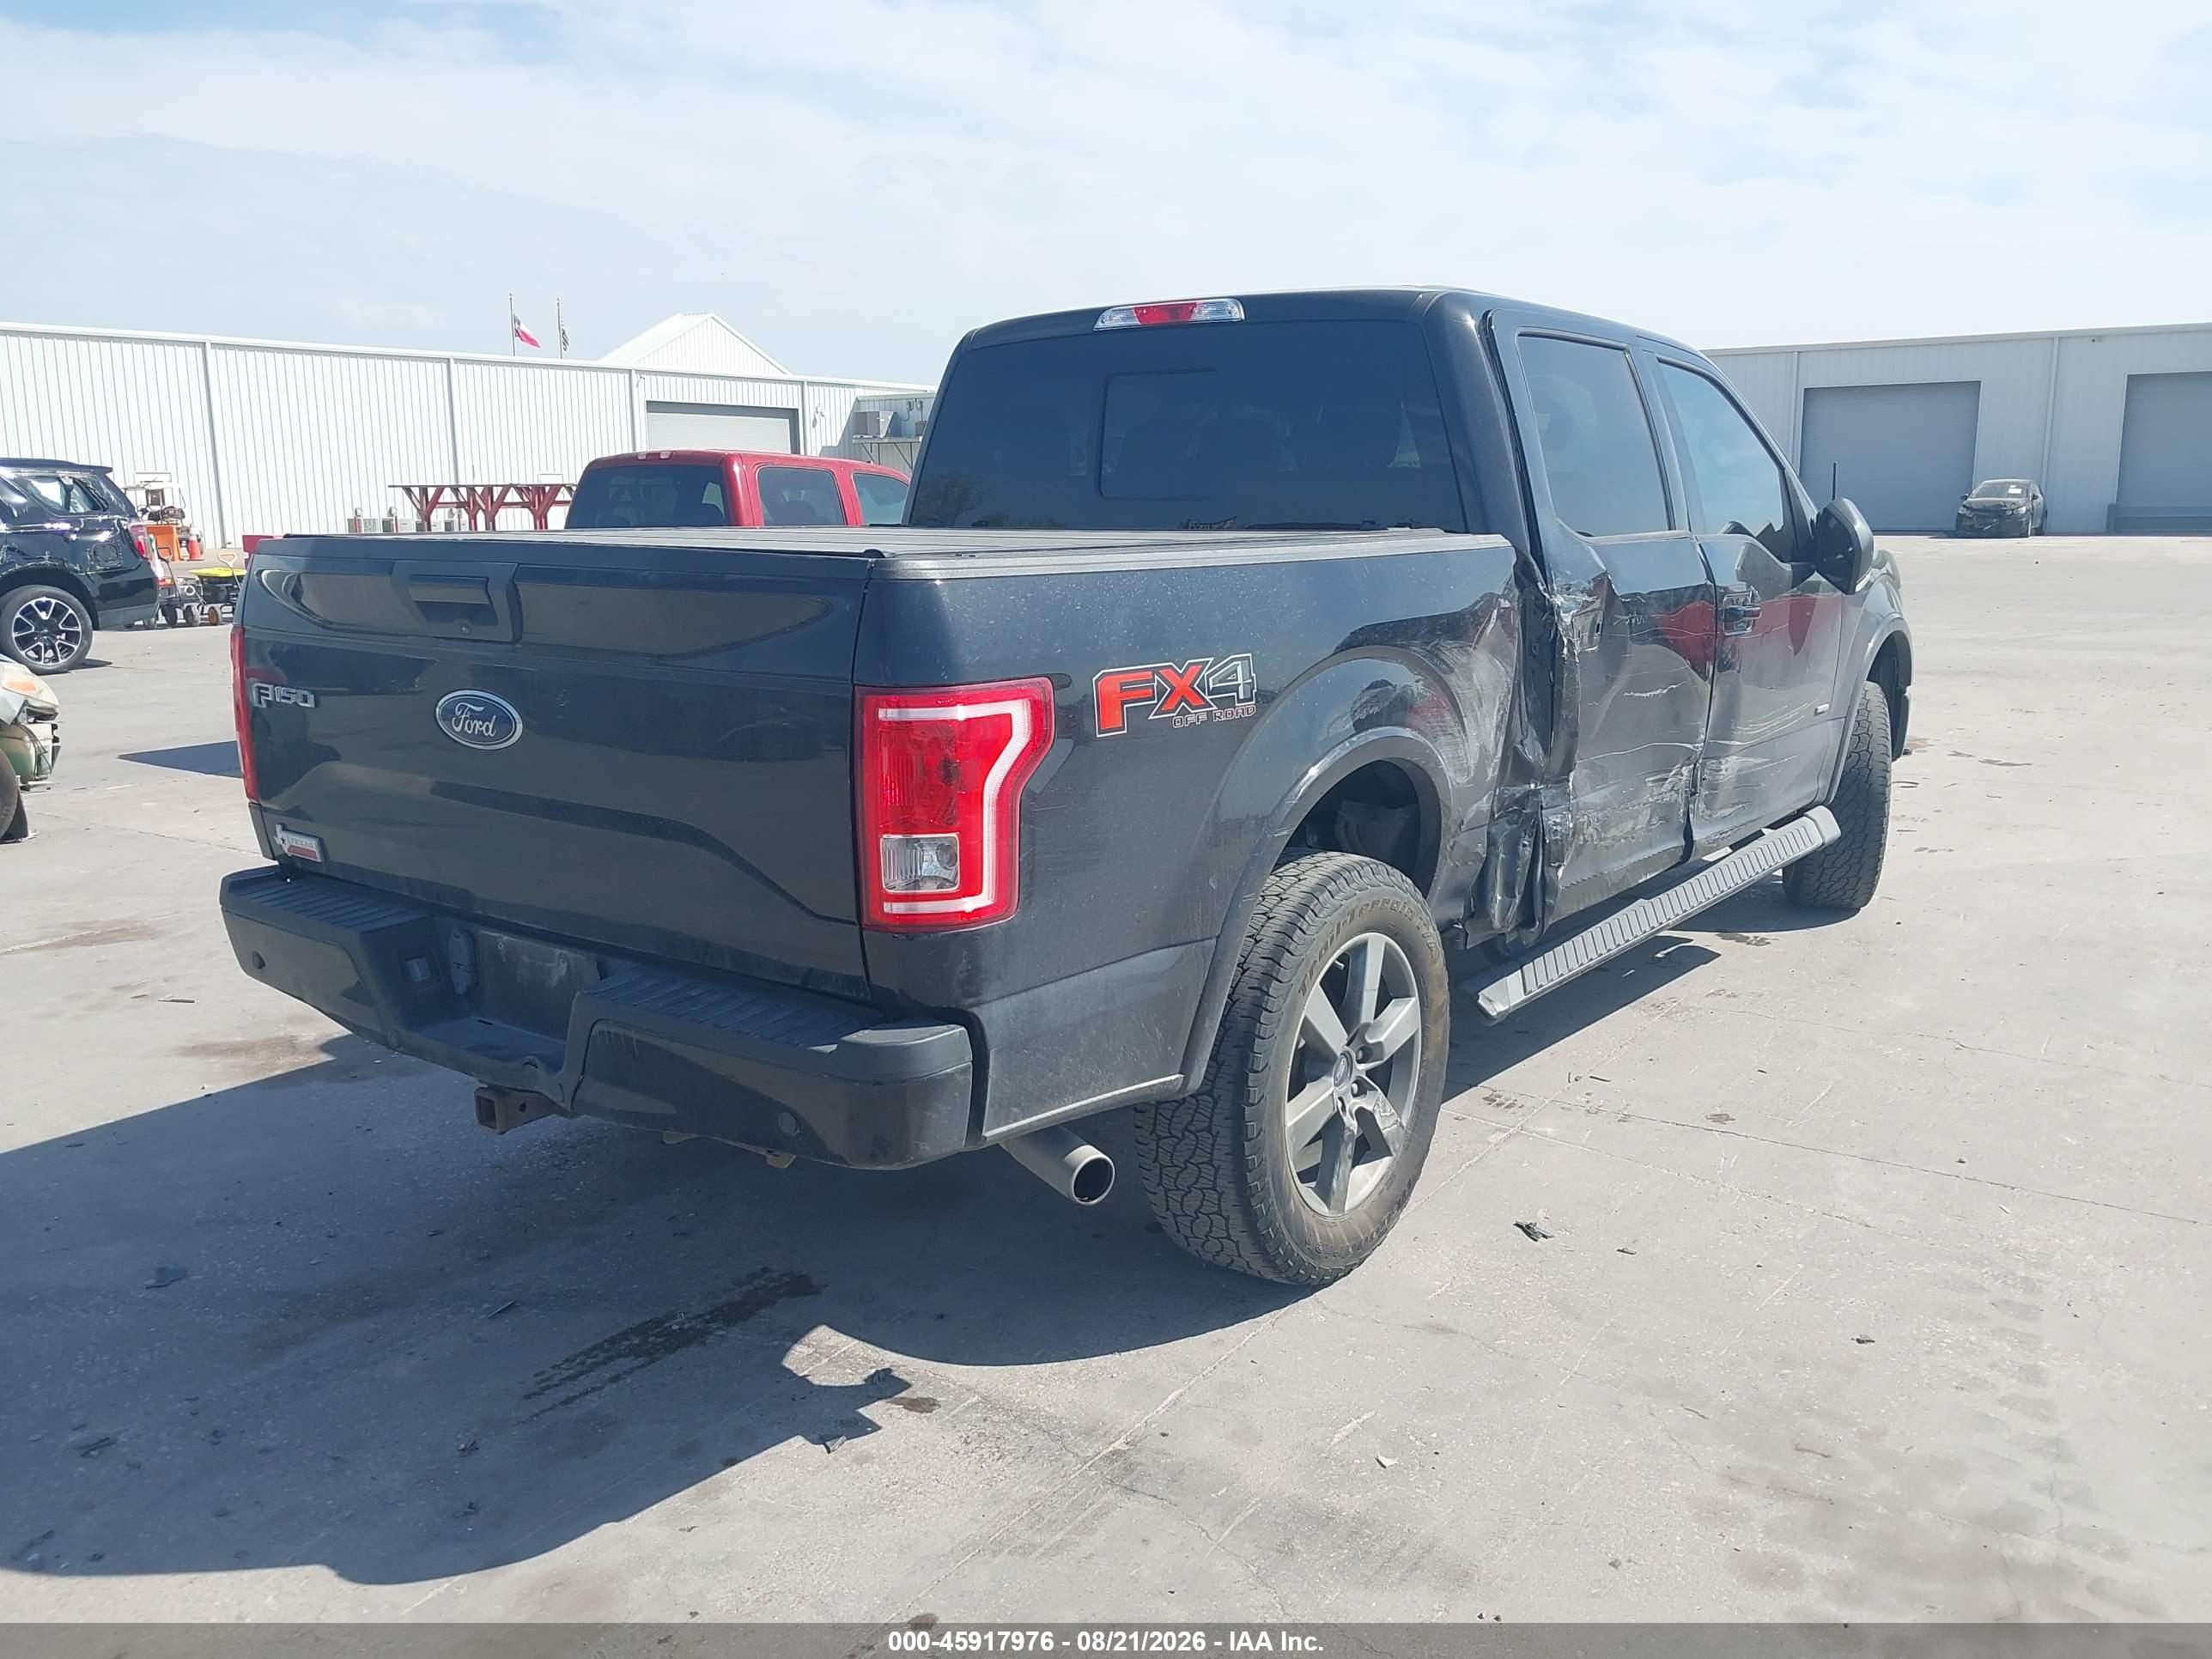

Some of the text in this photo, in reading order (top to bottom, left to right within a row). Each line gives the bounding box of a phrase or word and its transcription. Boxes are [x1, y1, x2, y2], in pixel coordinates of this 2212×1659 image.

[1092, 653, 1257, 738] FX4
[452, 702, 497, 738] Ford
[1172, 705, 1257, 729] OFF ROAD
